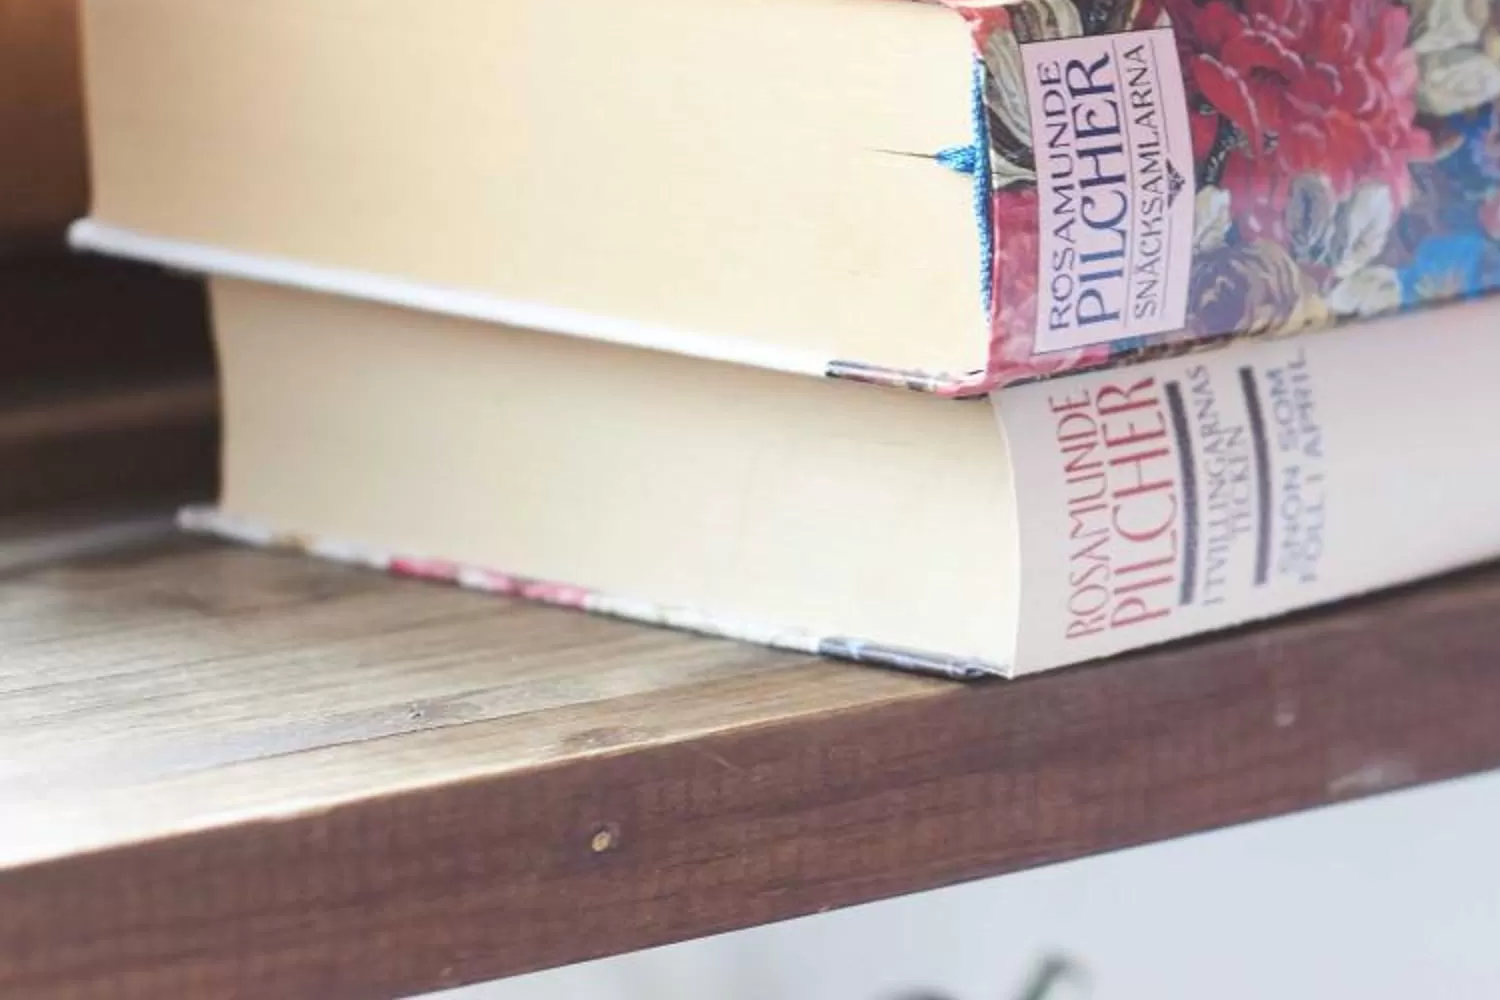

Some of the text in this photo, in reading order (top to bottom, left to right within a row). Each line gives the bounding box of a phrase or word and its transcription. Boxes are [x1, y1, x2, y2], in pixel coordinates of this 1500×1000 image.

[1037, 59, 1077, 331] ROSAMUNDE
[1065, 51, 1128, 328] PILCHER
[1048, 387, 1111, 640] ROSAMUNDE
[1095, 376, 1178, 630] PILCHER
